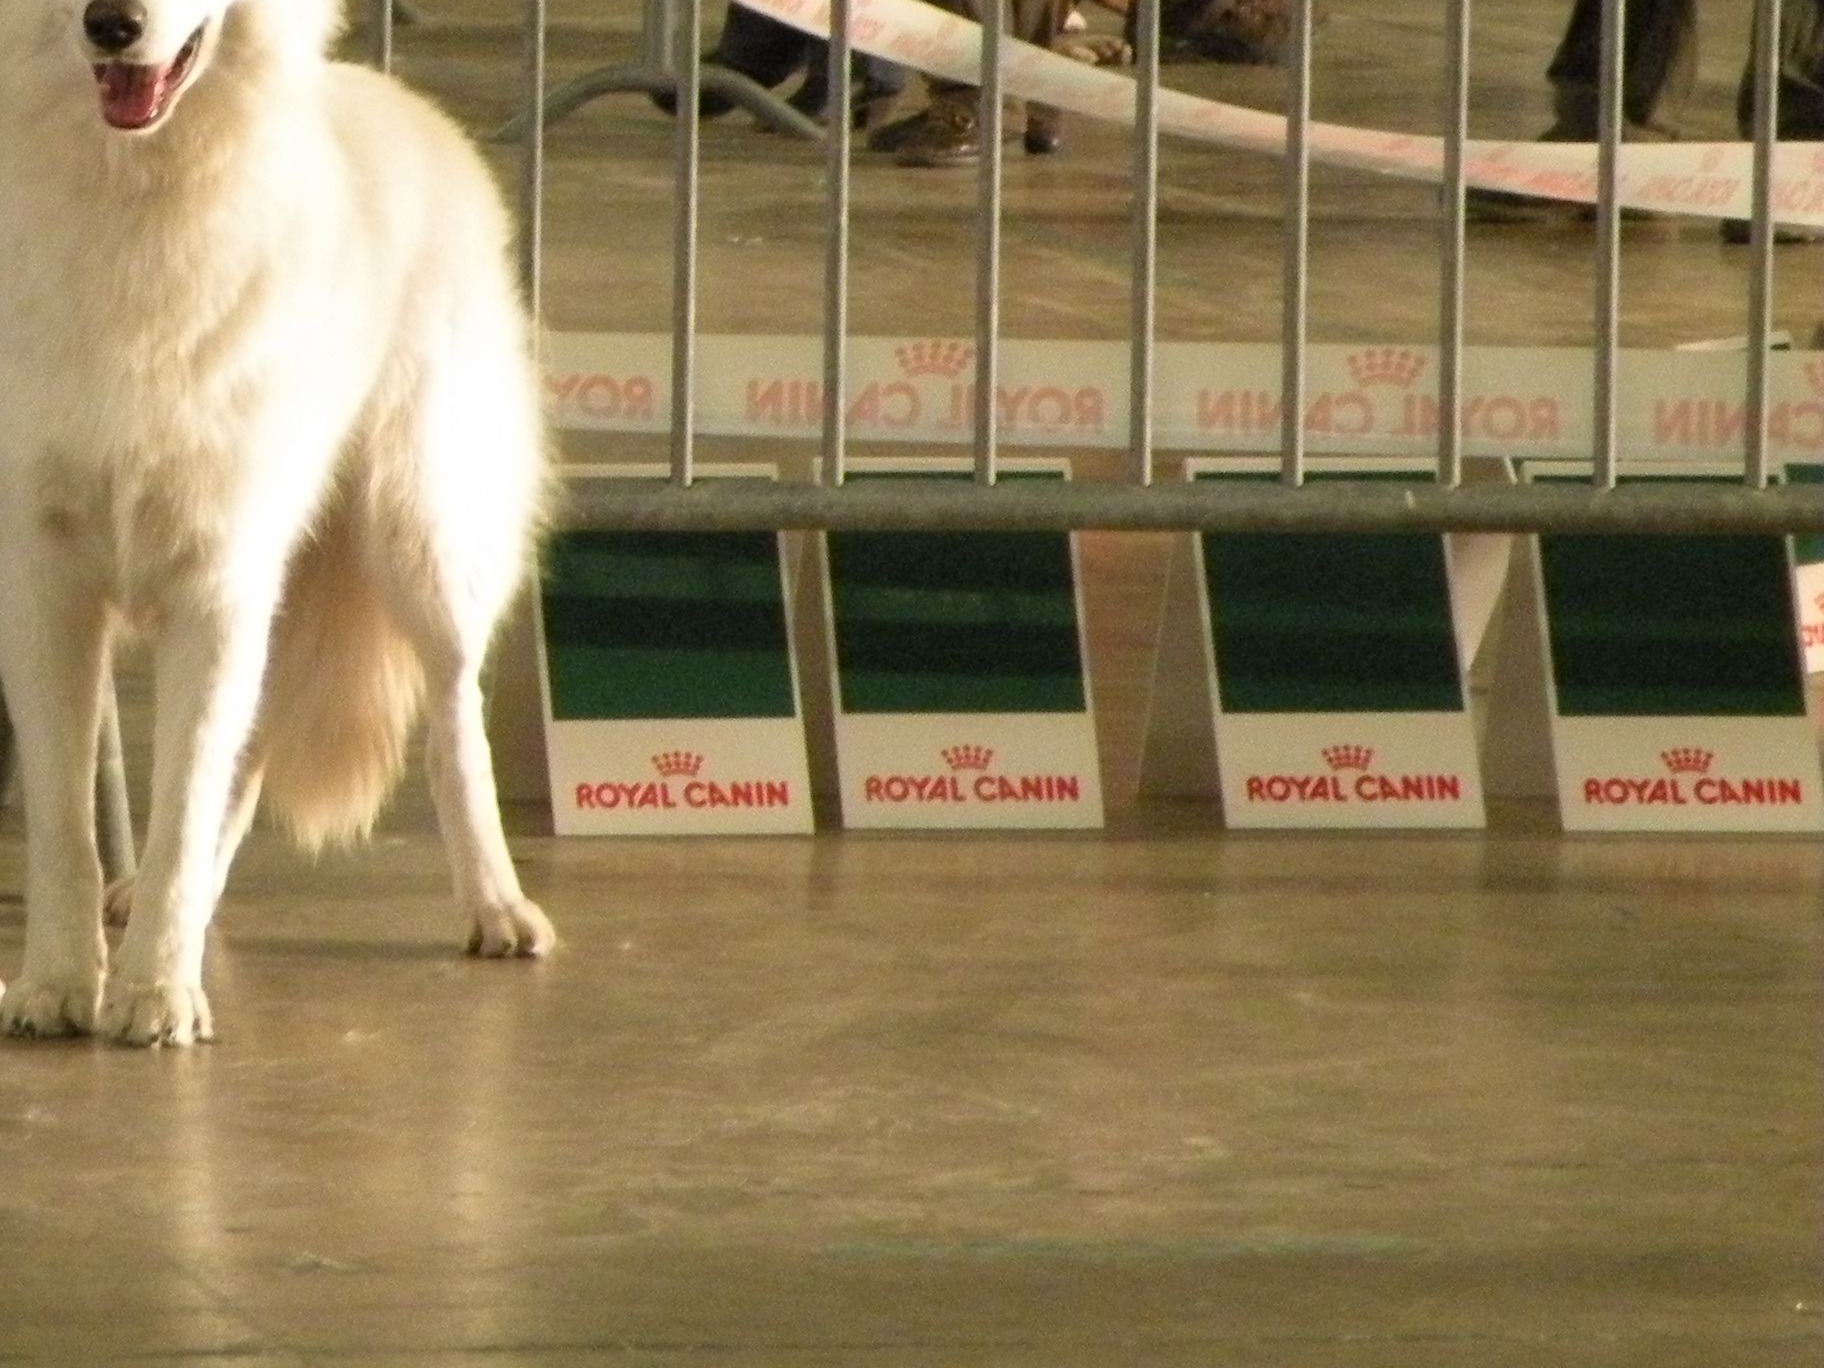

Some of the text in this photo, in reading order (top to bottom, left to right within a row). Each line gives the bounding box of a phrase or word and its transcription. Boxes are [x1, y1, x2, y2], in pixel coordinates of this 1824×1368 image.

[576, 781, 789, 808] ROYAL CANIN
[865, 775, 1081, 802] ROYAL CANIN
[1247, 774, 1460, 802] ROYAL CANIN
[1584, 778, 1800, 804] ROYAL CANIN
